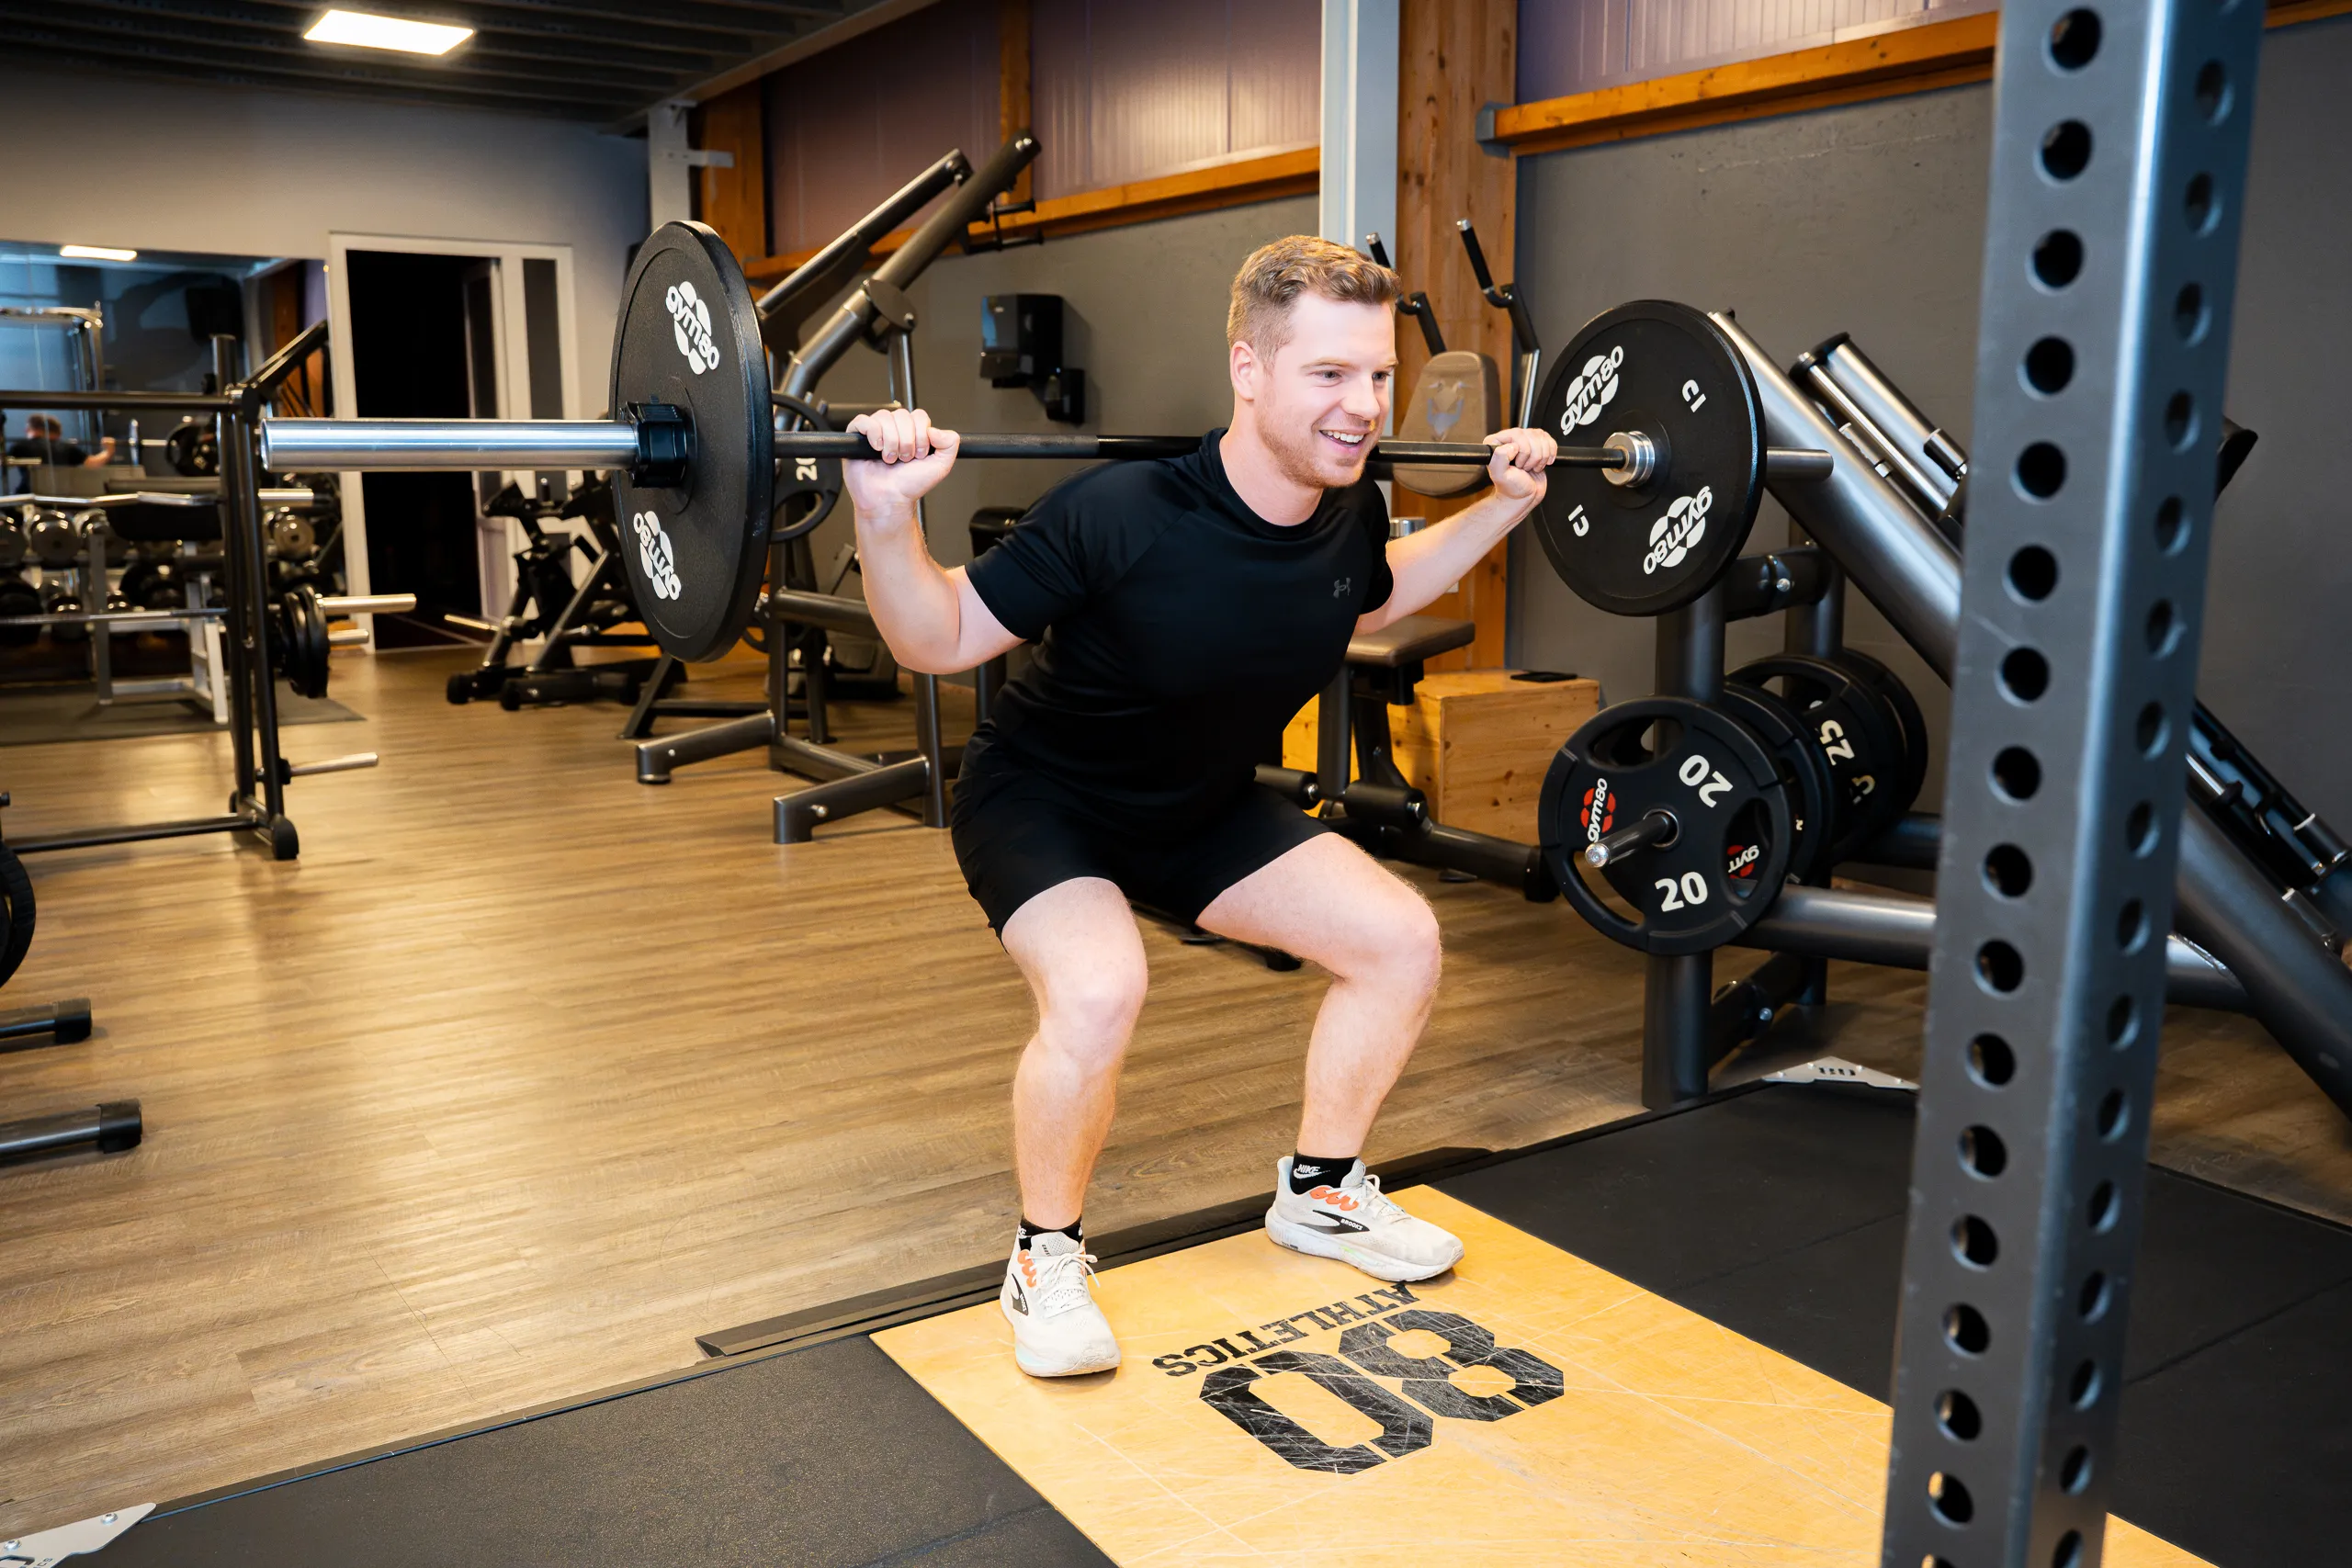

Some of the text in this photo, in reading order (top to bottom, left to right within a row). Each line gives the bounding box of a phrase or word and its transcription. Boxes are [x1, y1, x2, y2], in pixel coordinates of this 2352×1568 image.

[665, 285, 720, 370] gym80
[1560, 344, 1624, 436] gym80
[633, 512, 682, 601] gym80
[1643, 485, 1713, 575] gym80
[1587, 777, 1608, 843] gym80
[1679, 754, 1734, 808] 20
[1654, 871, 1709, 913] 20
[1296, 1163, 1321, 1175] NIKE
[1340, 1218, 1363, 1232] BROOKS
[1151, 1281, 1420, 1377] ATHLETICS
[1198, 1309, 1565, 1475] 80
